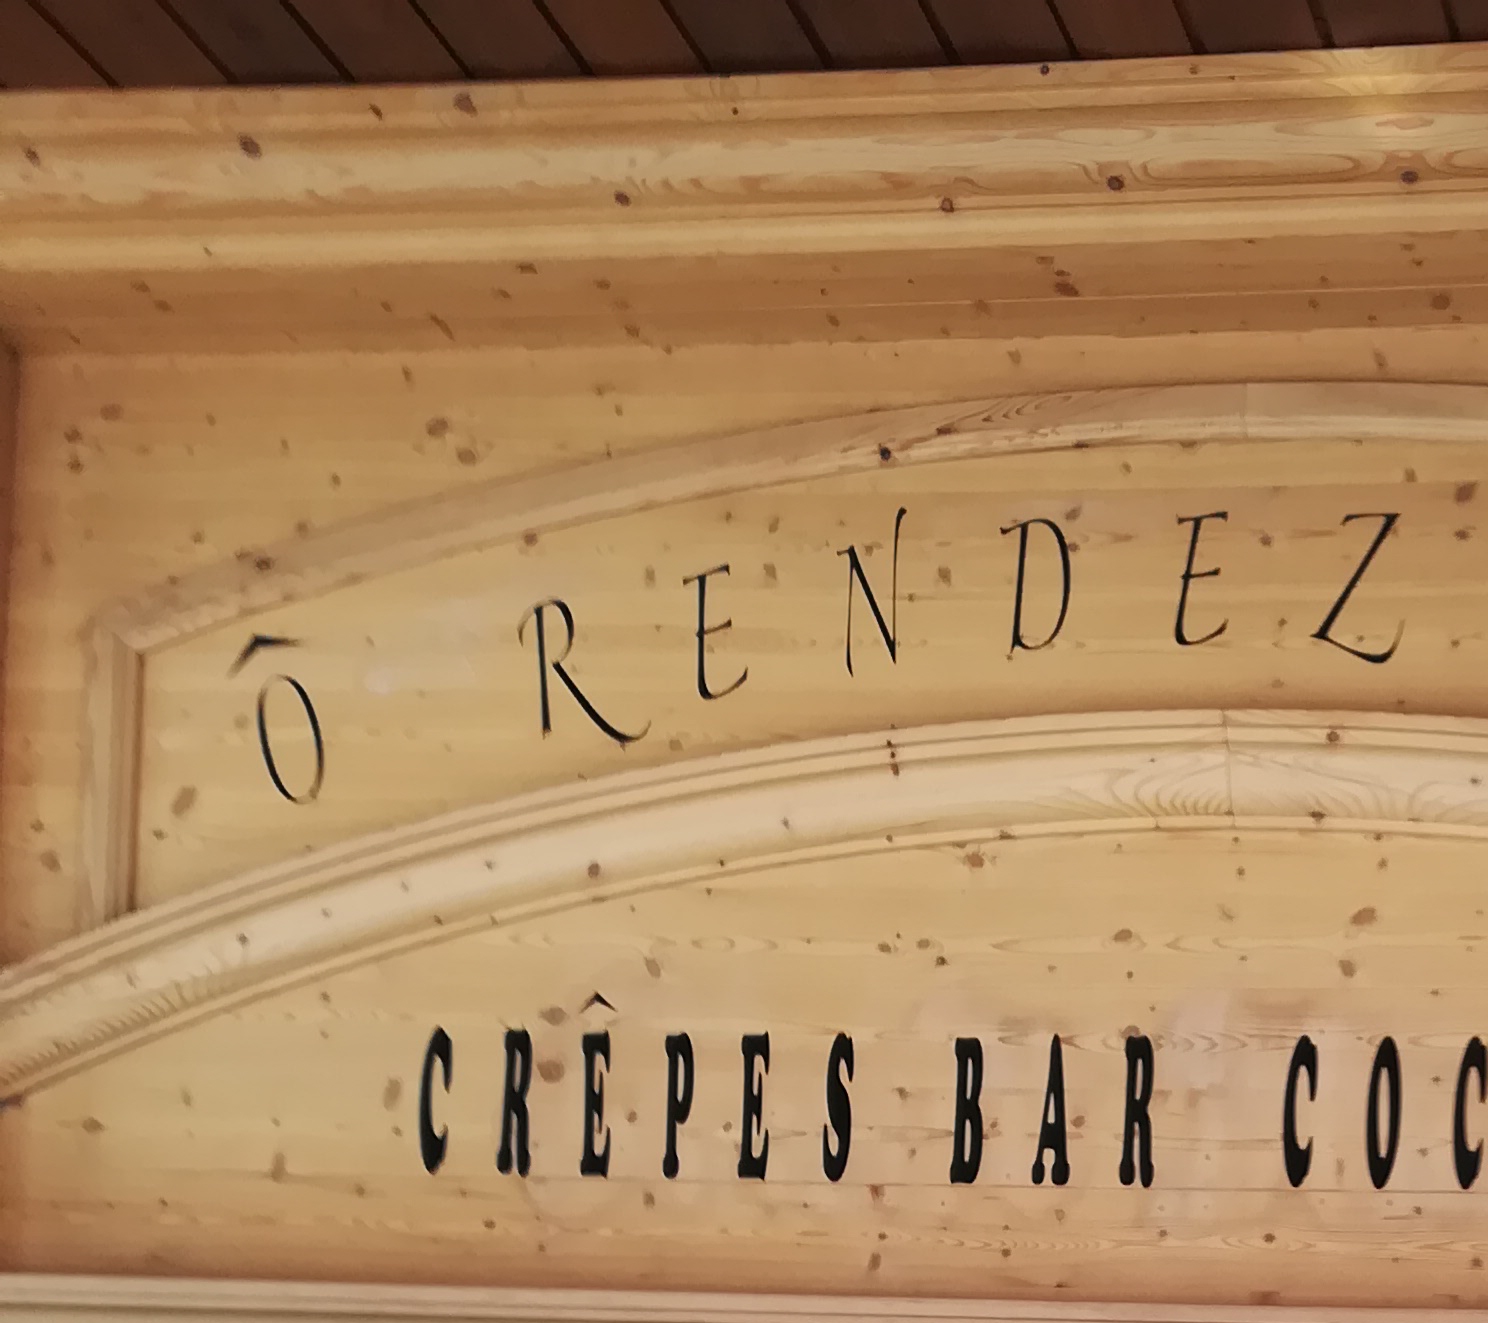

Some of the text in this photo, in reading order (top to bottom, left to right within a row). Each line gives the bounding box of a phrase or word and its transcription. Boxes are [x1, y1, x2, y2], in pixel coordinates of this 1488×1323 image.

[228, 633, 325, 804] Ô
[420, 992, 856, 1183] CRÊPES
[950, 1034, 1156, 1188] BAR
